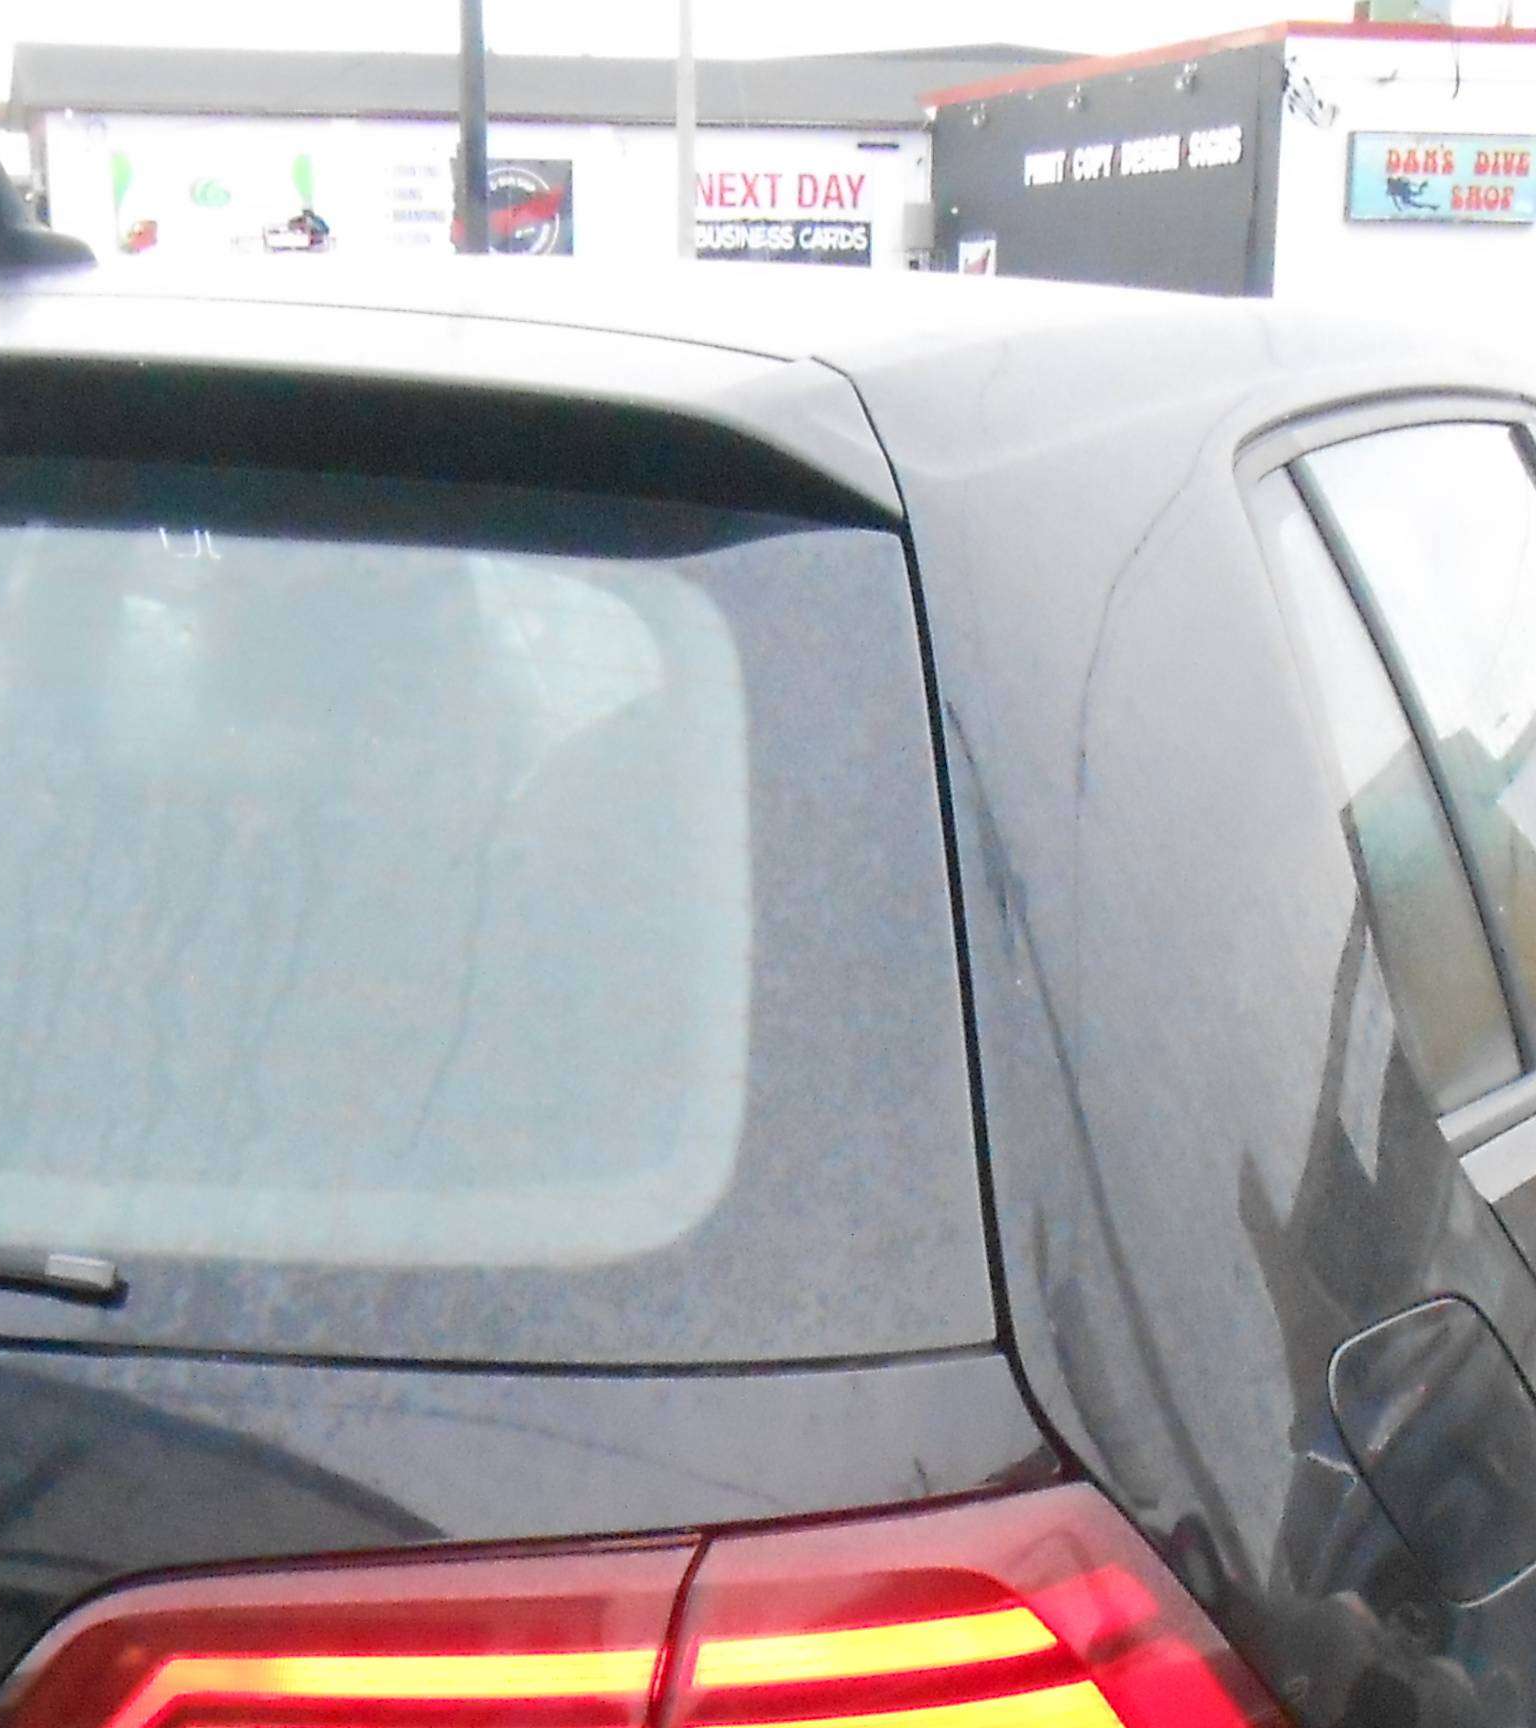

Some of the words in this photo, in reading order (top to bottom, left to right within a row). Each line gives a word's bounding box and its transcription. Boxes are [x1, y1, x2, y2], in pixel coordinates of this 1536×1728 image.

[1474, 151, 1531, 177] DIVE
[696, 173, 783, 208] NEXT
[797, 174, 866, 209] DAY
[1451, 184, 1514, 212] SHOP
[696, 224, 795, 250] BUSINESS
[799, 226, 868, 250] CARDS
